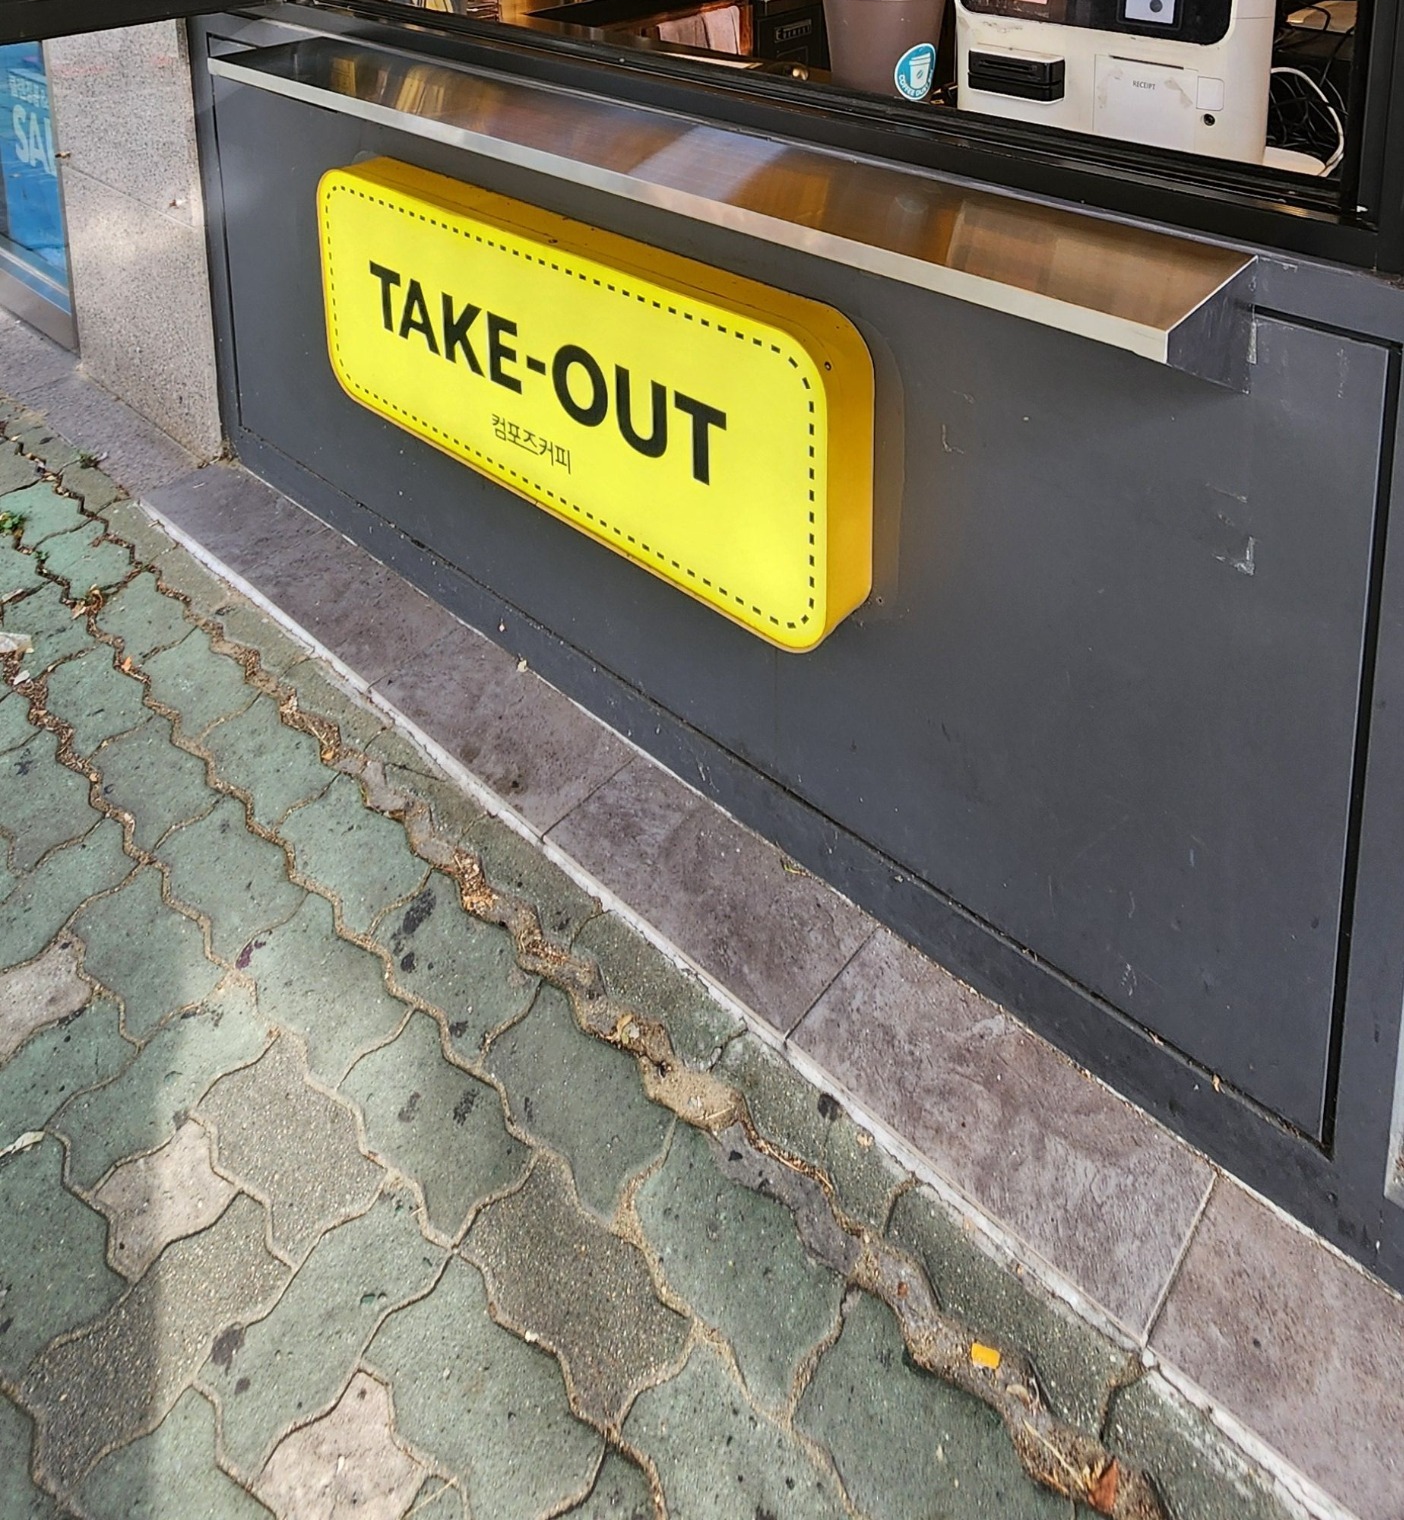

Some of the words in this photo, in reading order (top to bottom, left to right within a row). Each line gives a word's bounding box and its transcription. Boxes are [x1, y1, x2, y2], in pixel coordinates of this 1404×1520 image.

[1132, 80, 1156, 91] RECEIPT
[369, 260, 727, 486] TAKE-OUT
[491, 413, 571, 474] 컴포즈커피
